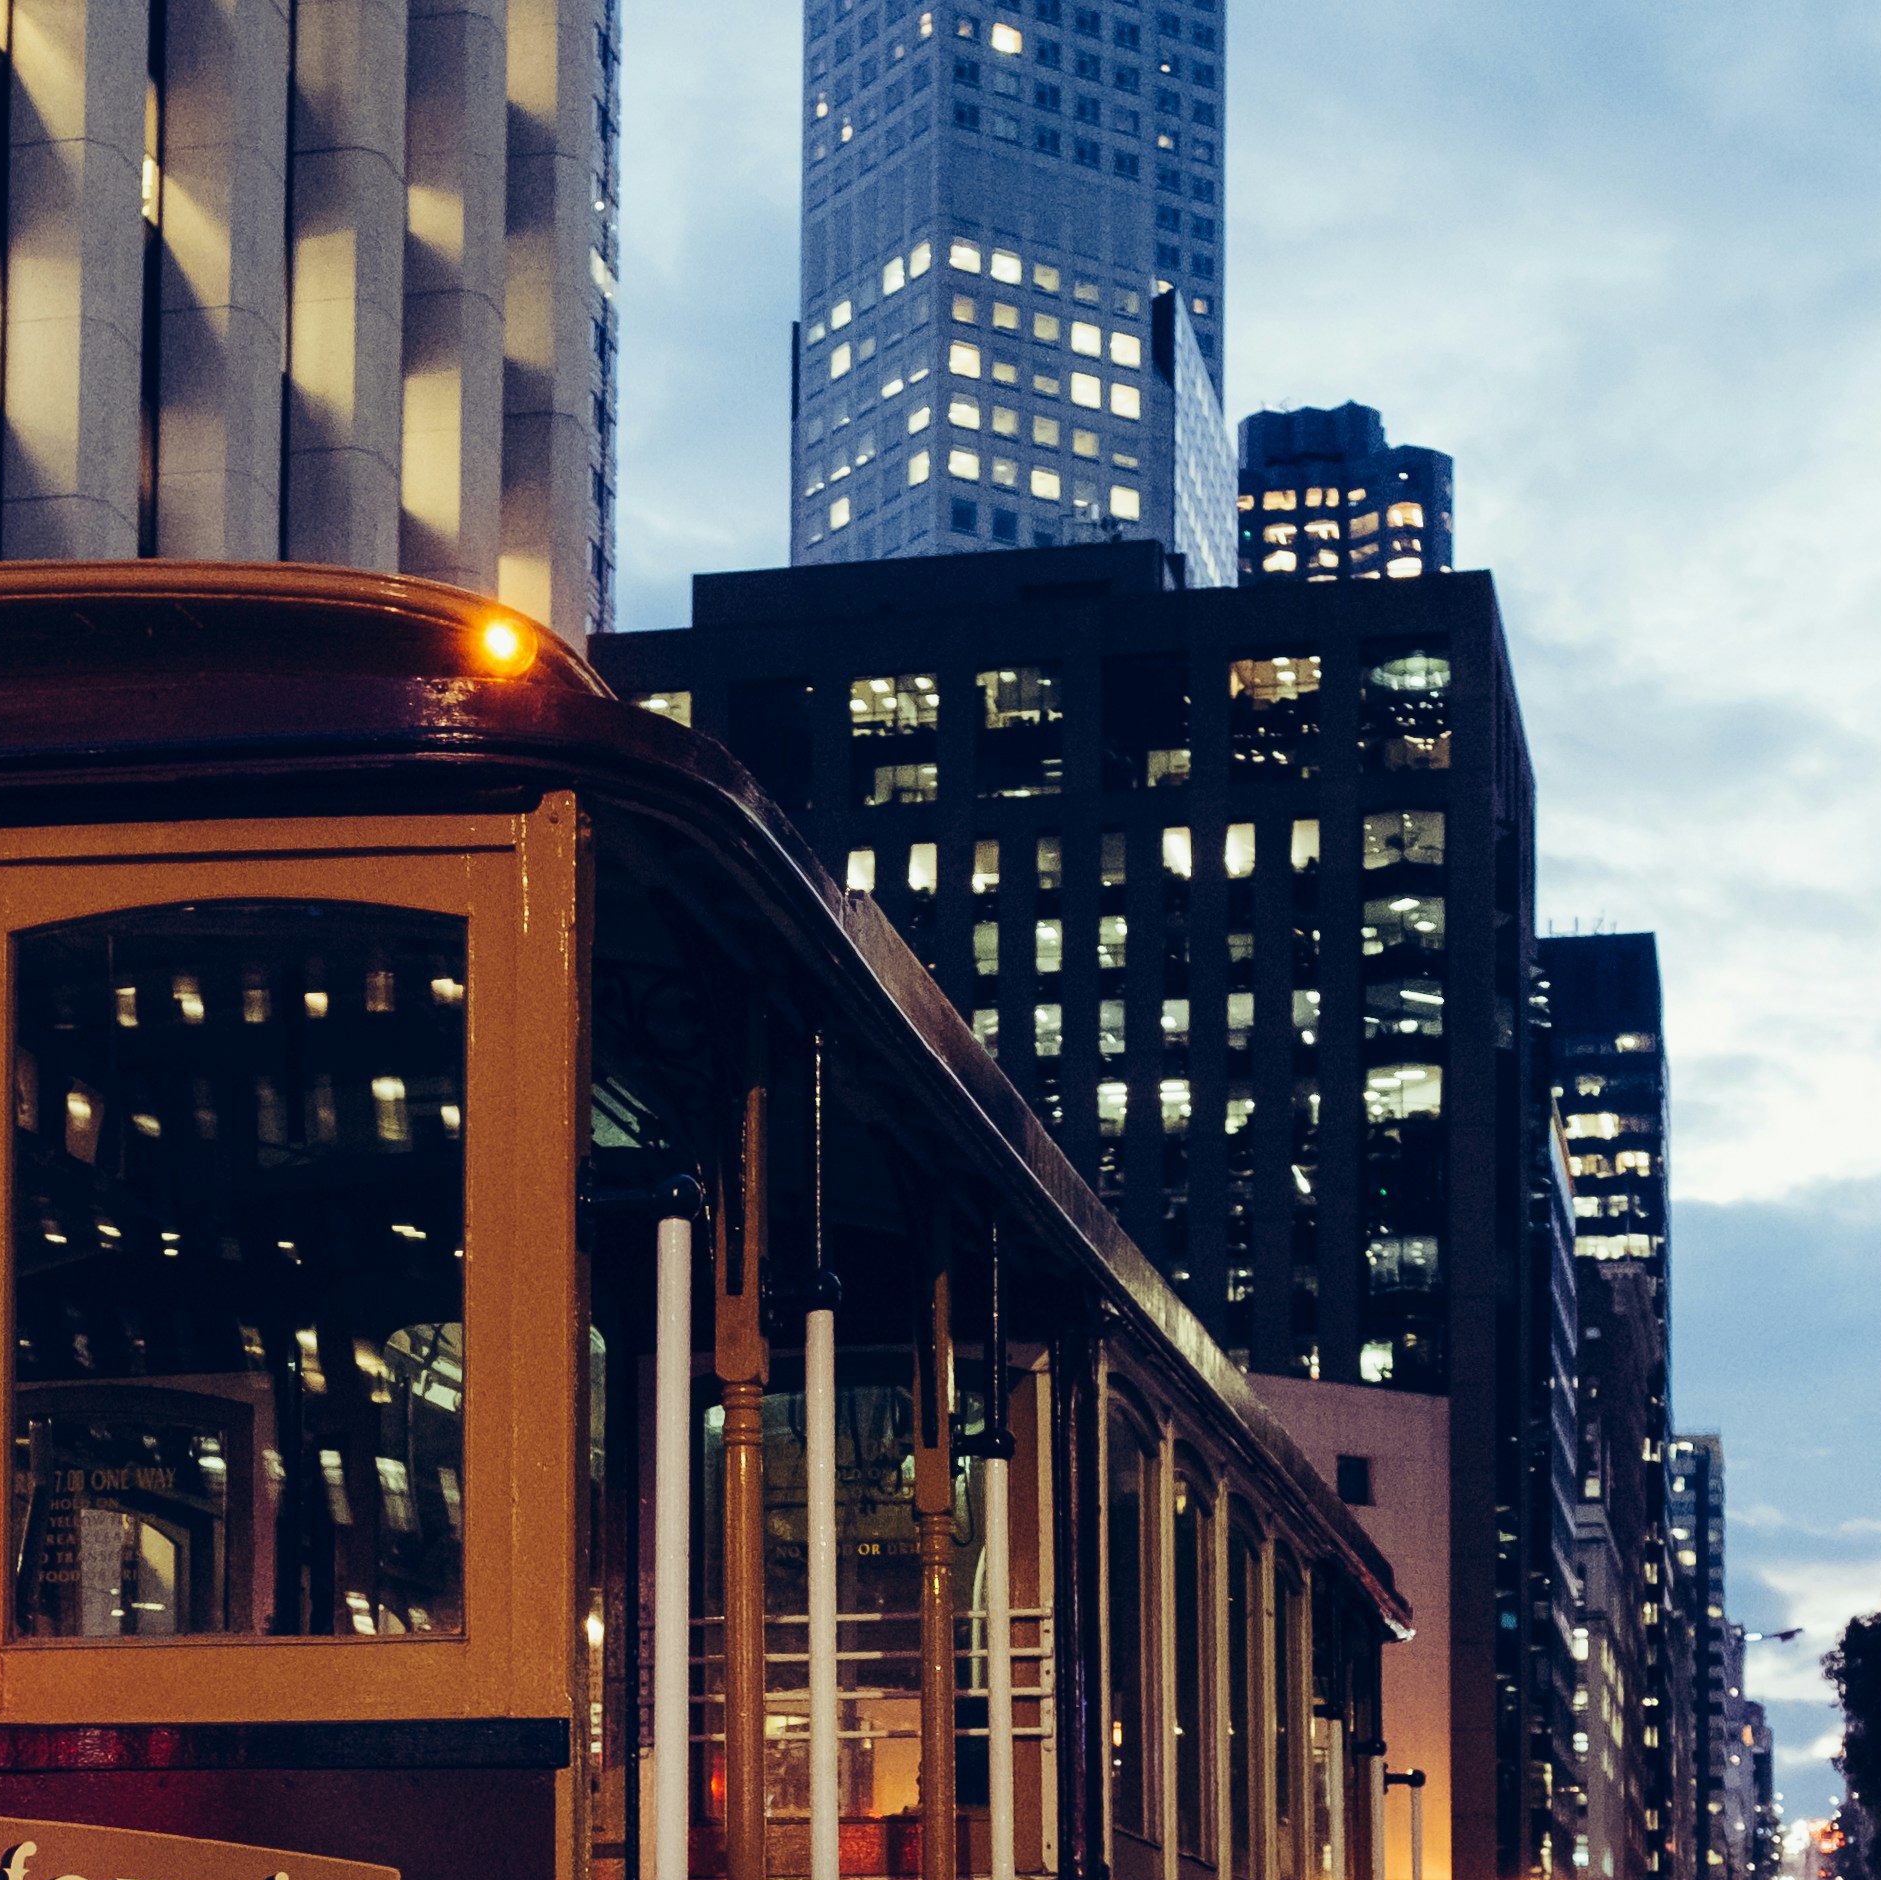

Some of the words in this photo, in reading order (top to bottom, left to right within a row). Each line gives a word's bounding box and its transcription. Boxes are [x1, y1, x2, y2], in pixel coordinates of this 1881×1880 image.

[91, 1467, 130, 1491] ONE
[136, 1466, 177, 1490] WAY
[857, 1542, 881, 1556] OR
